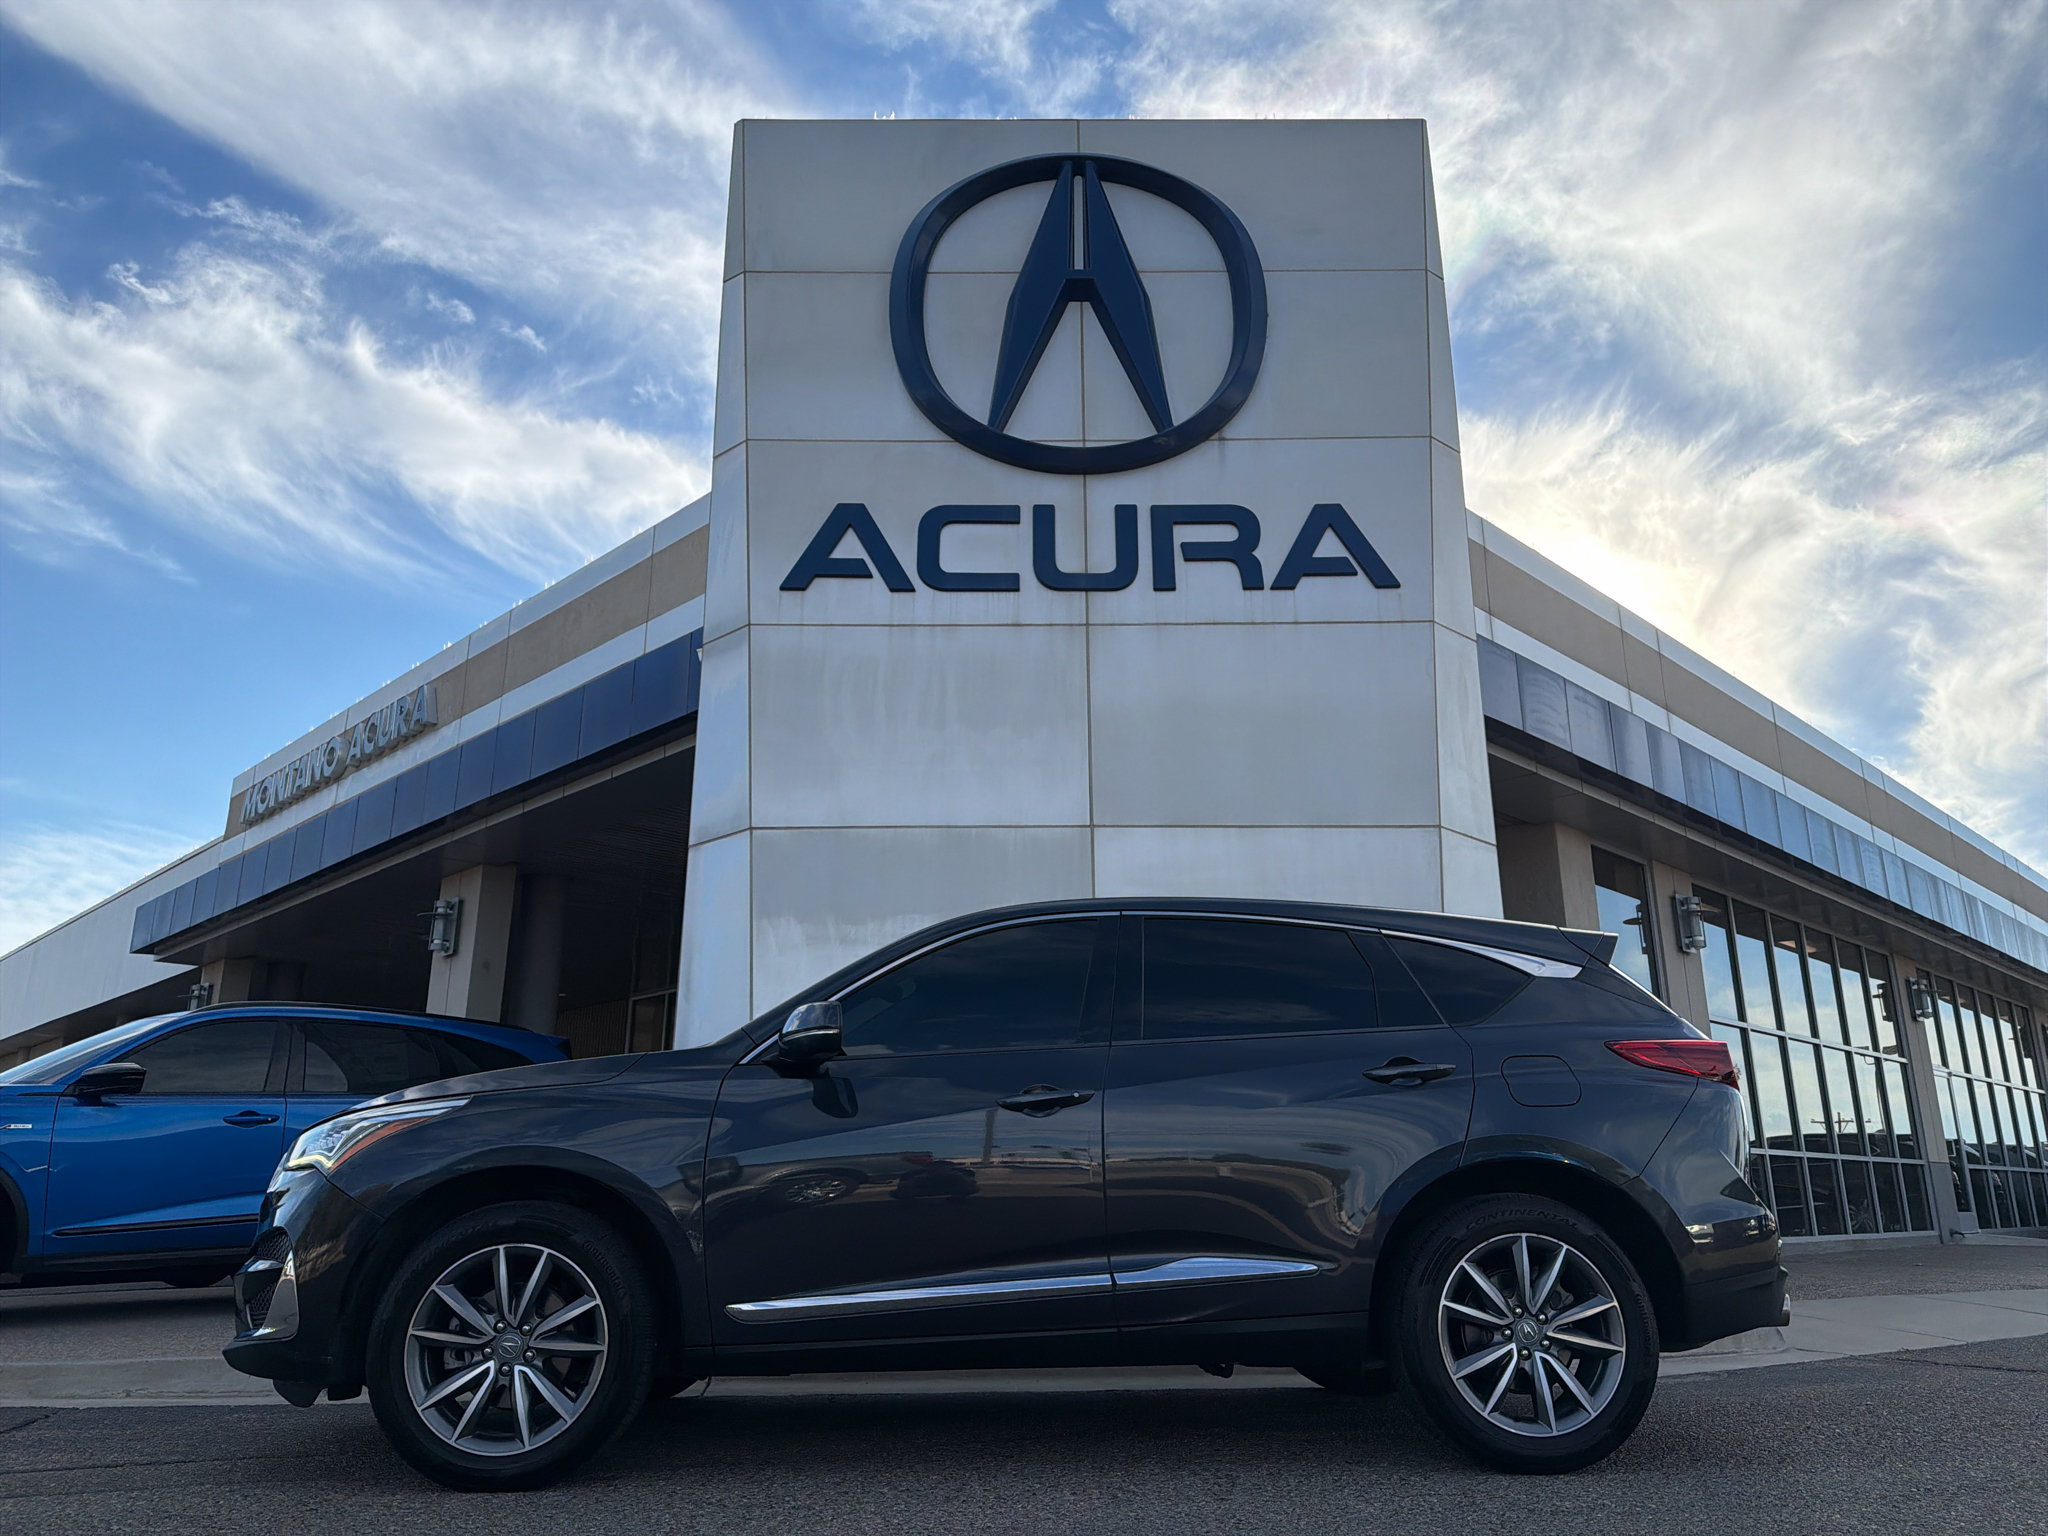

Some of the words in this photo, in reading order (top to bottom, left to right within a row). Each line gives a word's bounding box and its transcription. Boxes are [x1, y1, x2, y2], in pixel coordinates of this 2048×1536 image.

[780, 503, 1401, 592] ACURA
[241, 736, 345, 824] MONTANO
[346, 684, 434, 768] ACURA
[1465, 1208, 1579, 1231] CONTINENTAL
